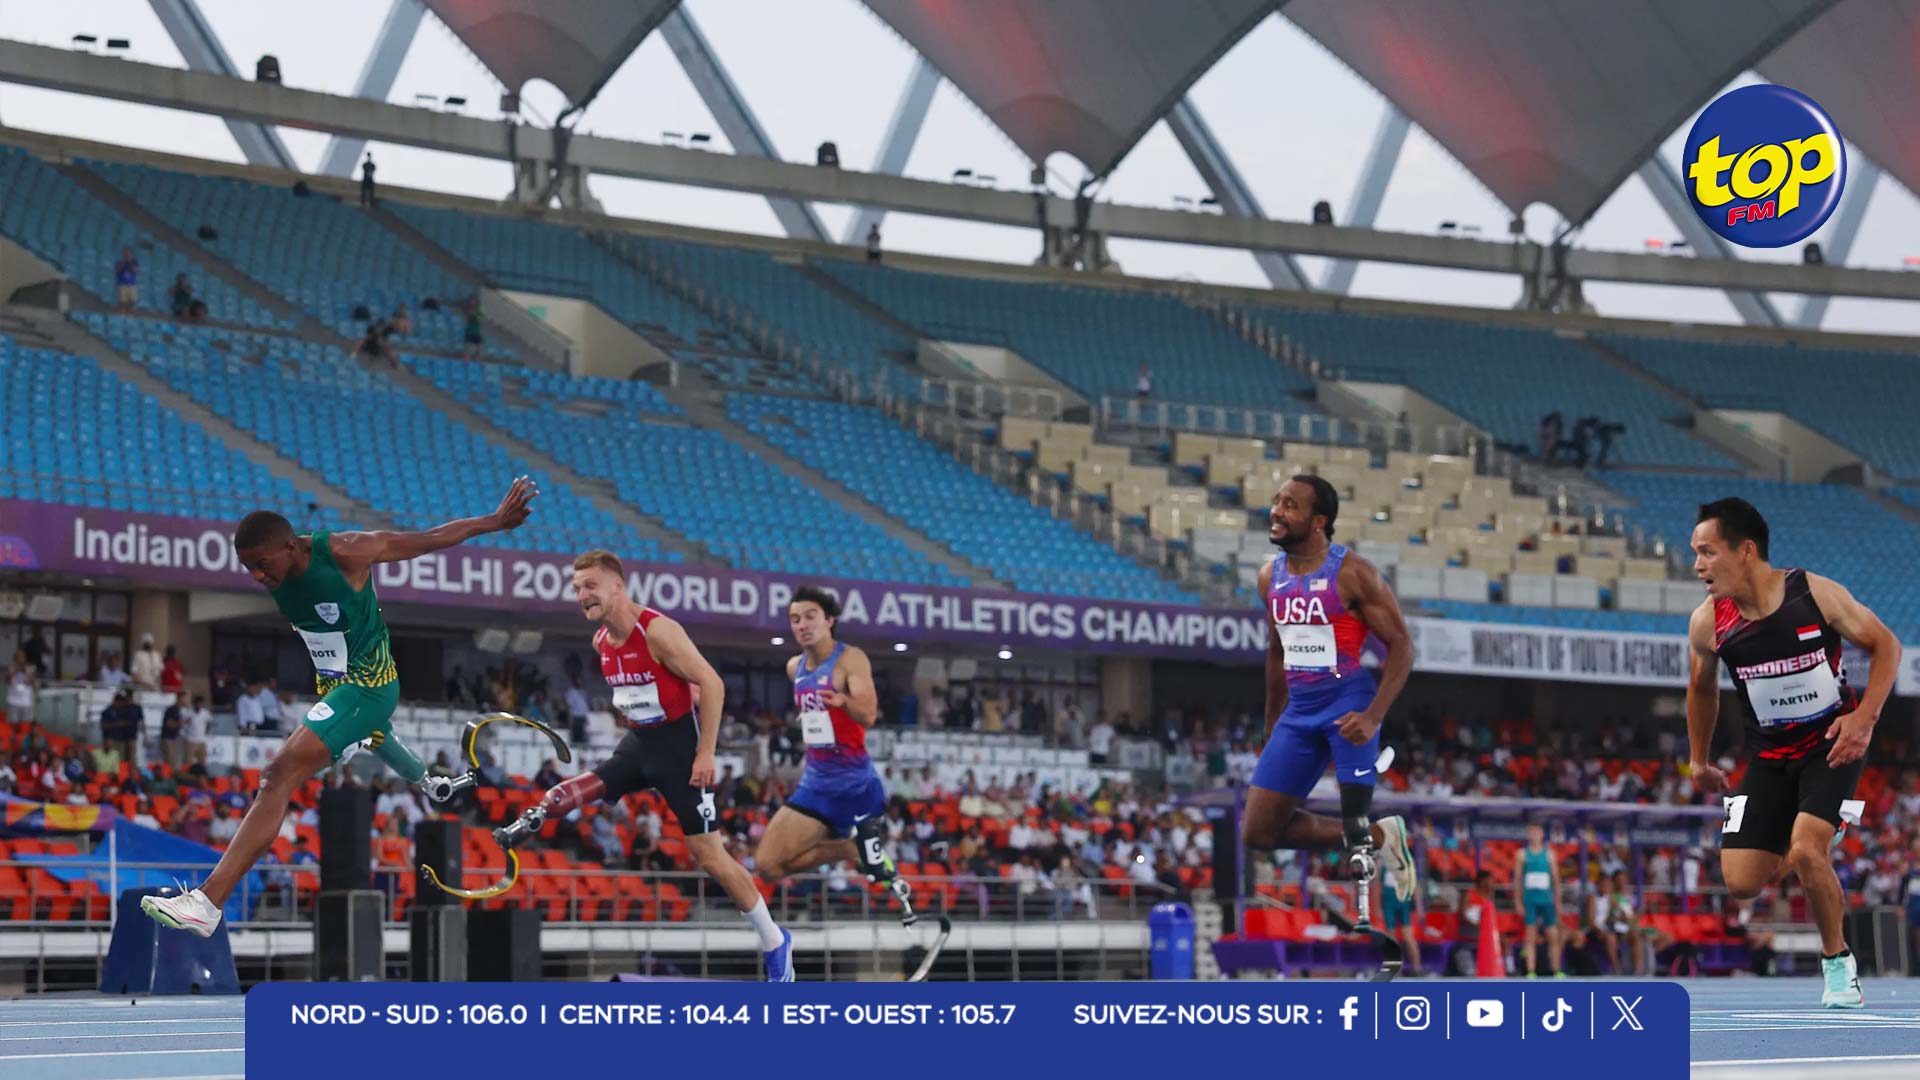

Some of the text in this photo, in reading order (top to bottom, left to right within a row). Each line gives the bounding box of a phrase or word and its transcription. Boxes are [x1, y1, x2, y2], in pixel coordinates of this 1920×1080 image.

[74, 517, 249, 574] IndianOi
[378, 554, 504, 597] DELHI
[512, 561, 578, 603] 202
[626, 570, 759, 616] WORLD
[875, 591, 1076, 639] ATHLETICS
[1081, 606, 1269, 651] CHAMPION
[1272, 597, 1329, 625] USA
[1736, 647, 1827, 680] INDONESIA
[1769, 690, 1819, 707] PARTIN
